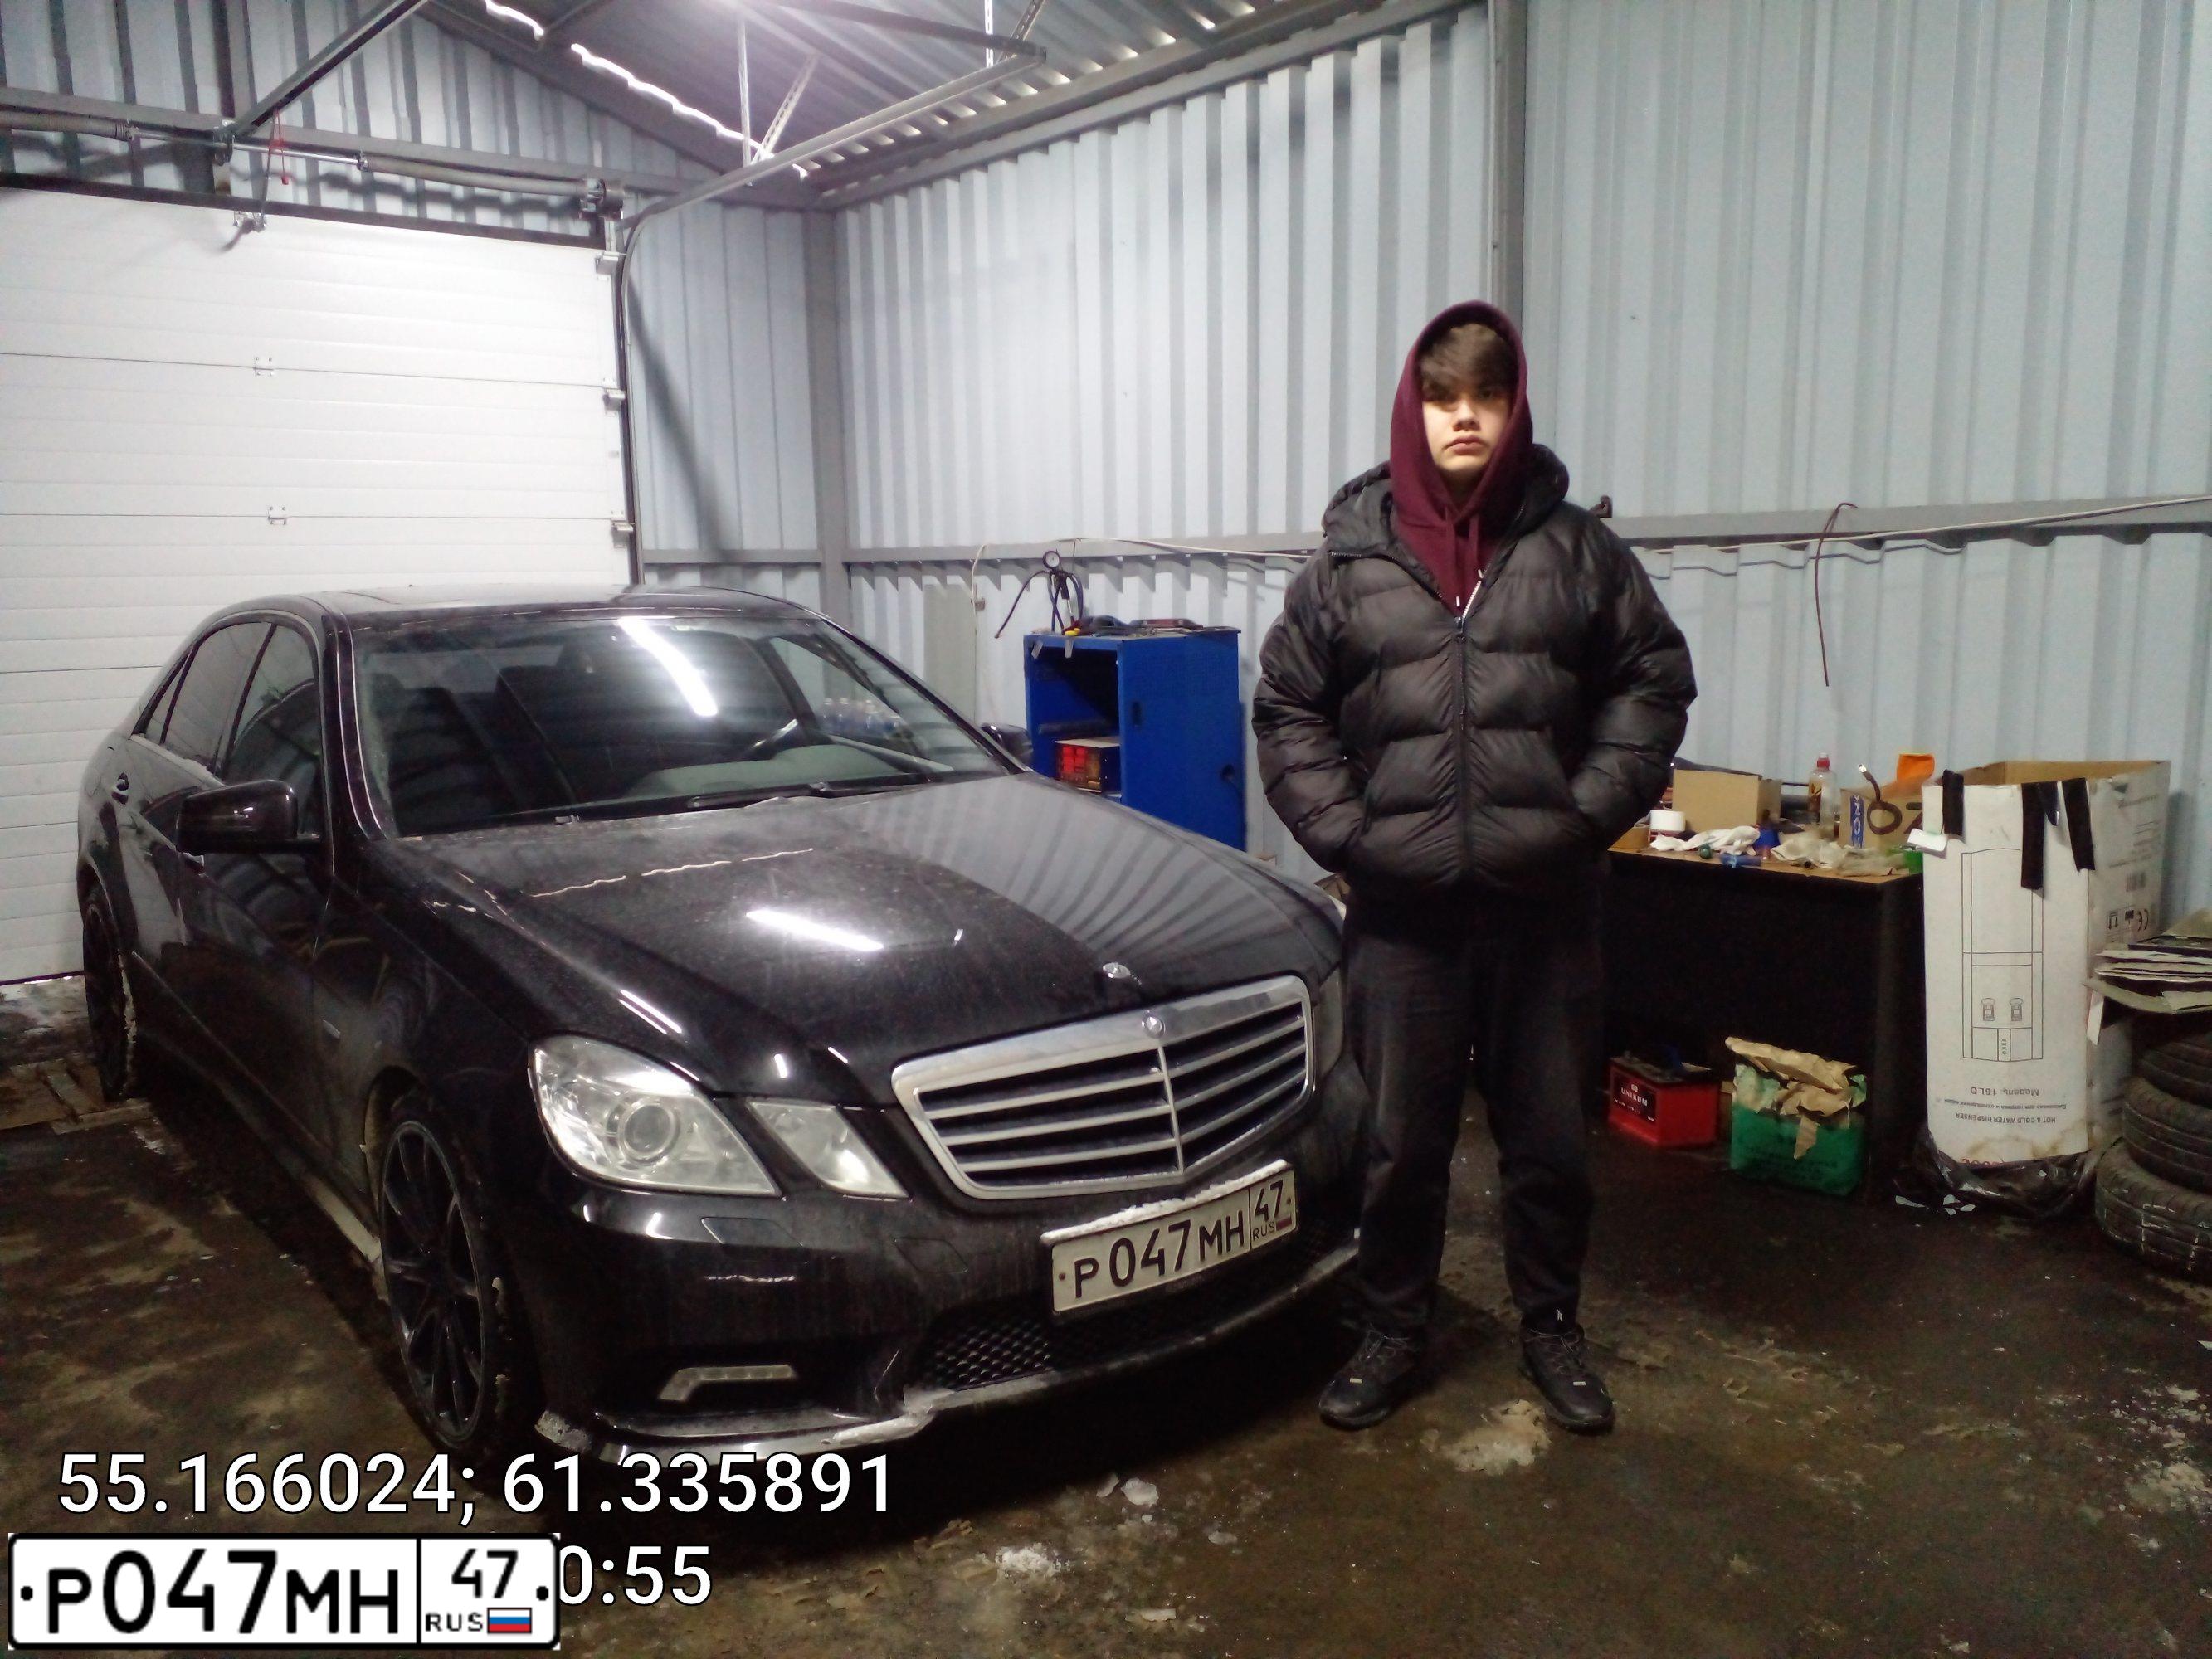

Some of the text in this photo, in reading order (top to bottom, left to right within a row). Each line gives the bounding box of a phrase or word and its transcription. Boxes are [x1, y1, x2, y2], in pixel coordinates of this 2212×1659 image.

[1956, 1112, 1992, 1122] DISPENSER
[1993, 1116, 2016, 1124] WATER
[1255, 1179, 1284, 1221] 47
[1252, 1221, 1276, 1242] RUS
